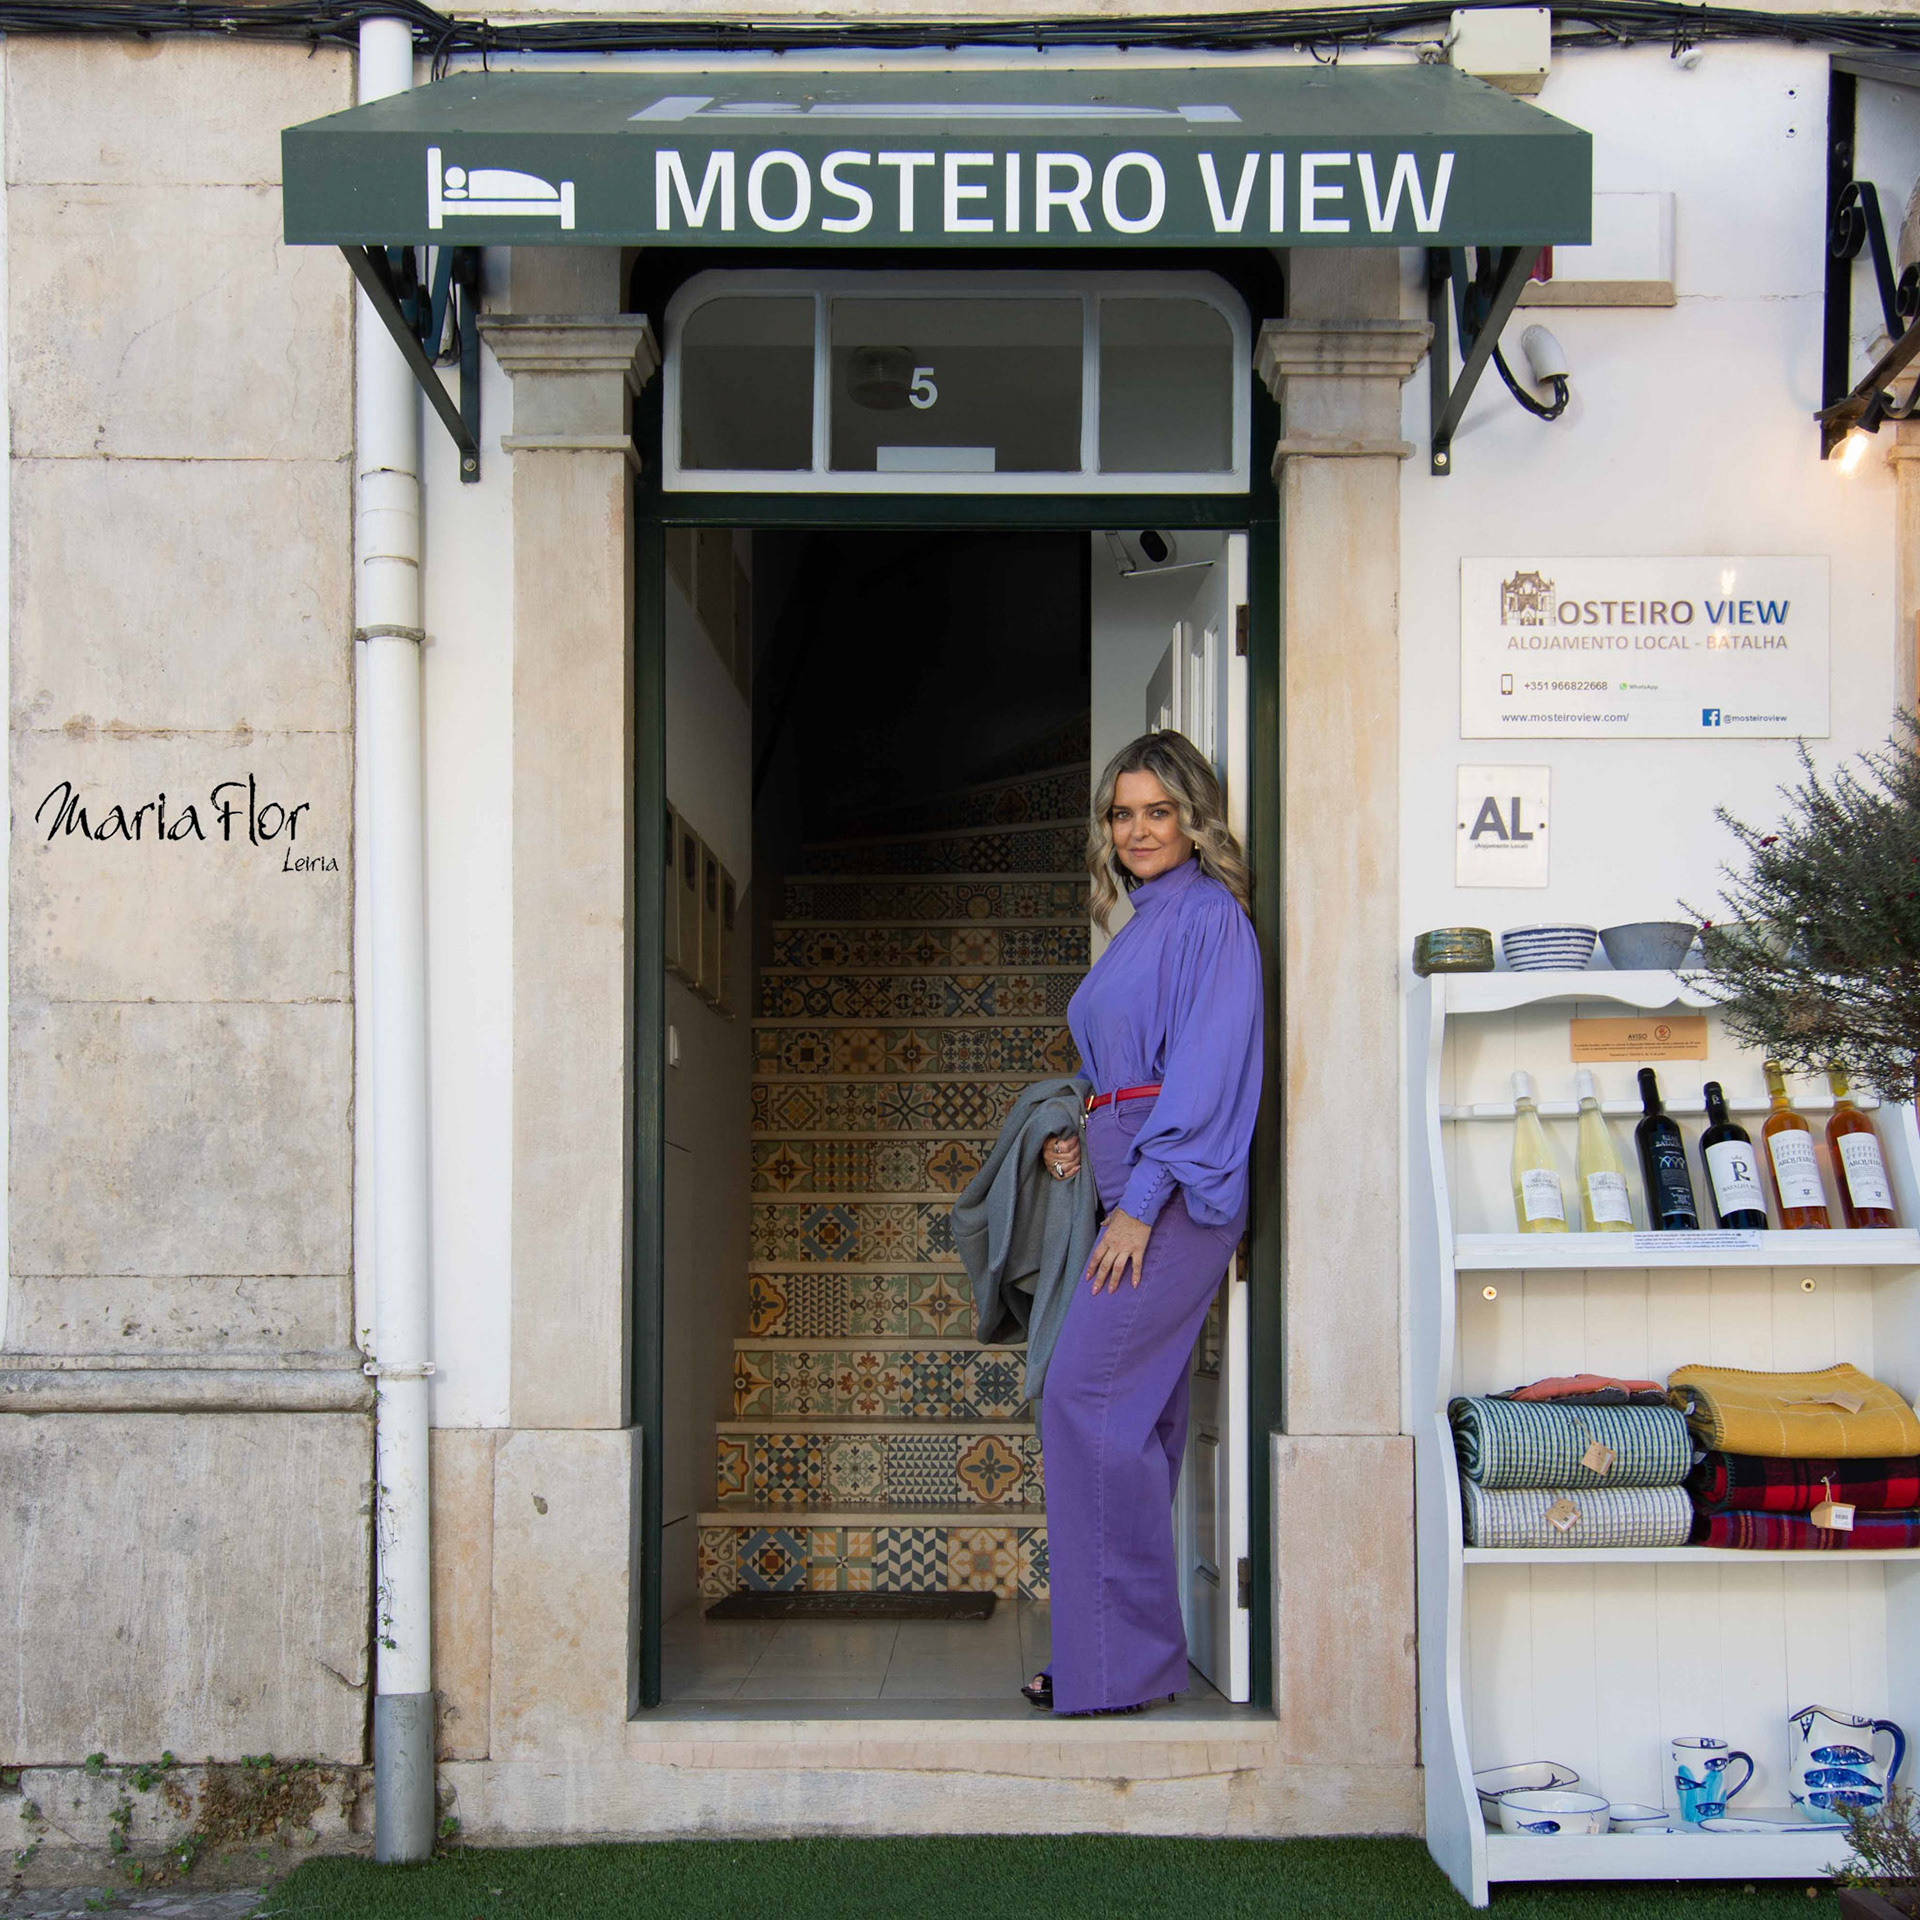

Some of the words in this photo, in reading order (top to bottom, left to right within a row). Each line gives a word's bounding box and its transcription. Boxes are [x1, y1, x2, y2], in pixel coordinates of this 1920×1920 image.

[655, 150, 1166, 234] MOSTEIRO
[1197, 152, 1455, 233] VIEW
[909, 368, 938, 408] 5
[1704, 600, 1791, 625] VIEW
[1507, 636, 1629, 650] ALOJAMENTO
[1635, 636, 1690, 650] LOCAL
[1706, 636, 1789, 650] BATALHA
[1524, 681, 1549, 690] +351
[1551, 681, 1608, 690] 966822668
[1502, 713, 1630, 723] www.mosteiroview.com/
[1723, 714, 1788, 723] @mosteiroview
[1469, 796, 1534, 841] AL
[1627, 1033, 1648, 1041] AVISO
[1729, 1161, 1751, 1182] R
